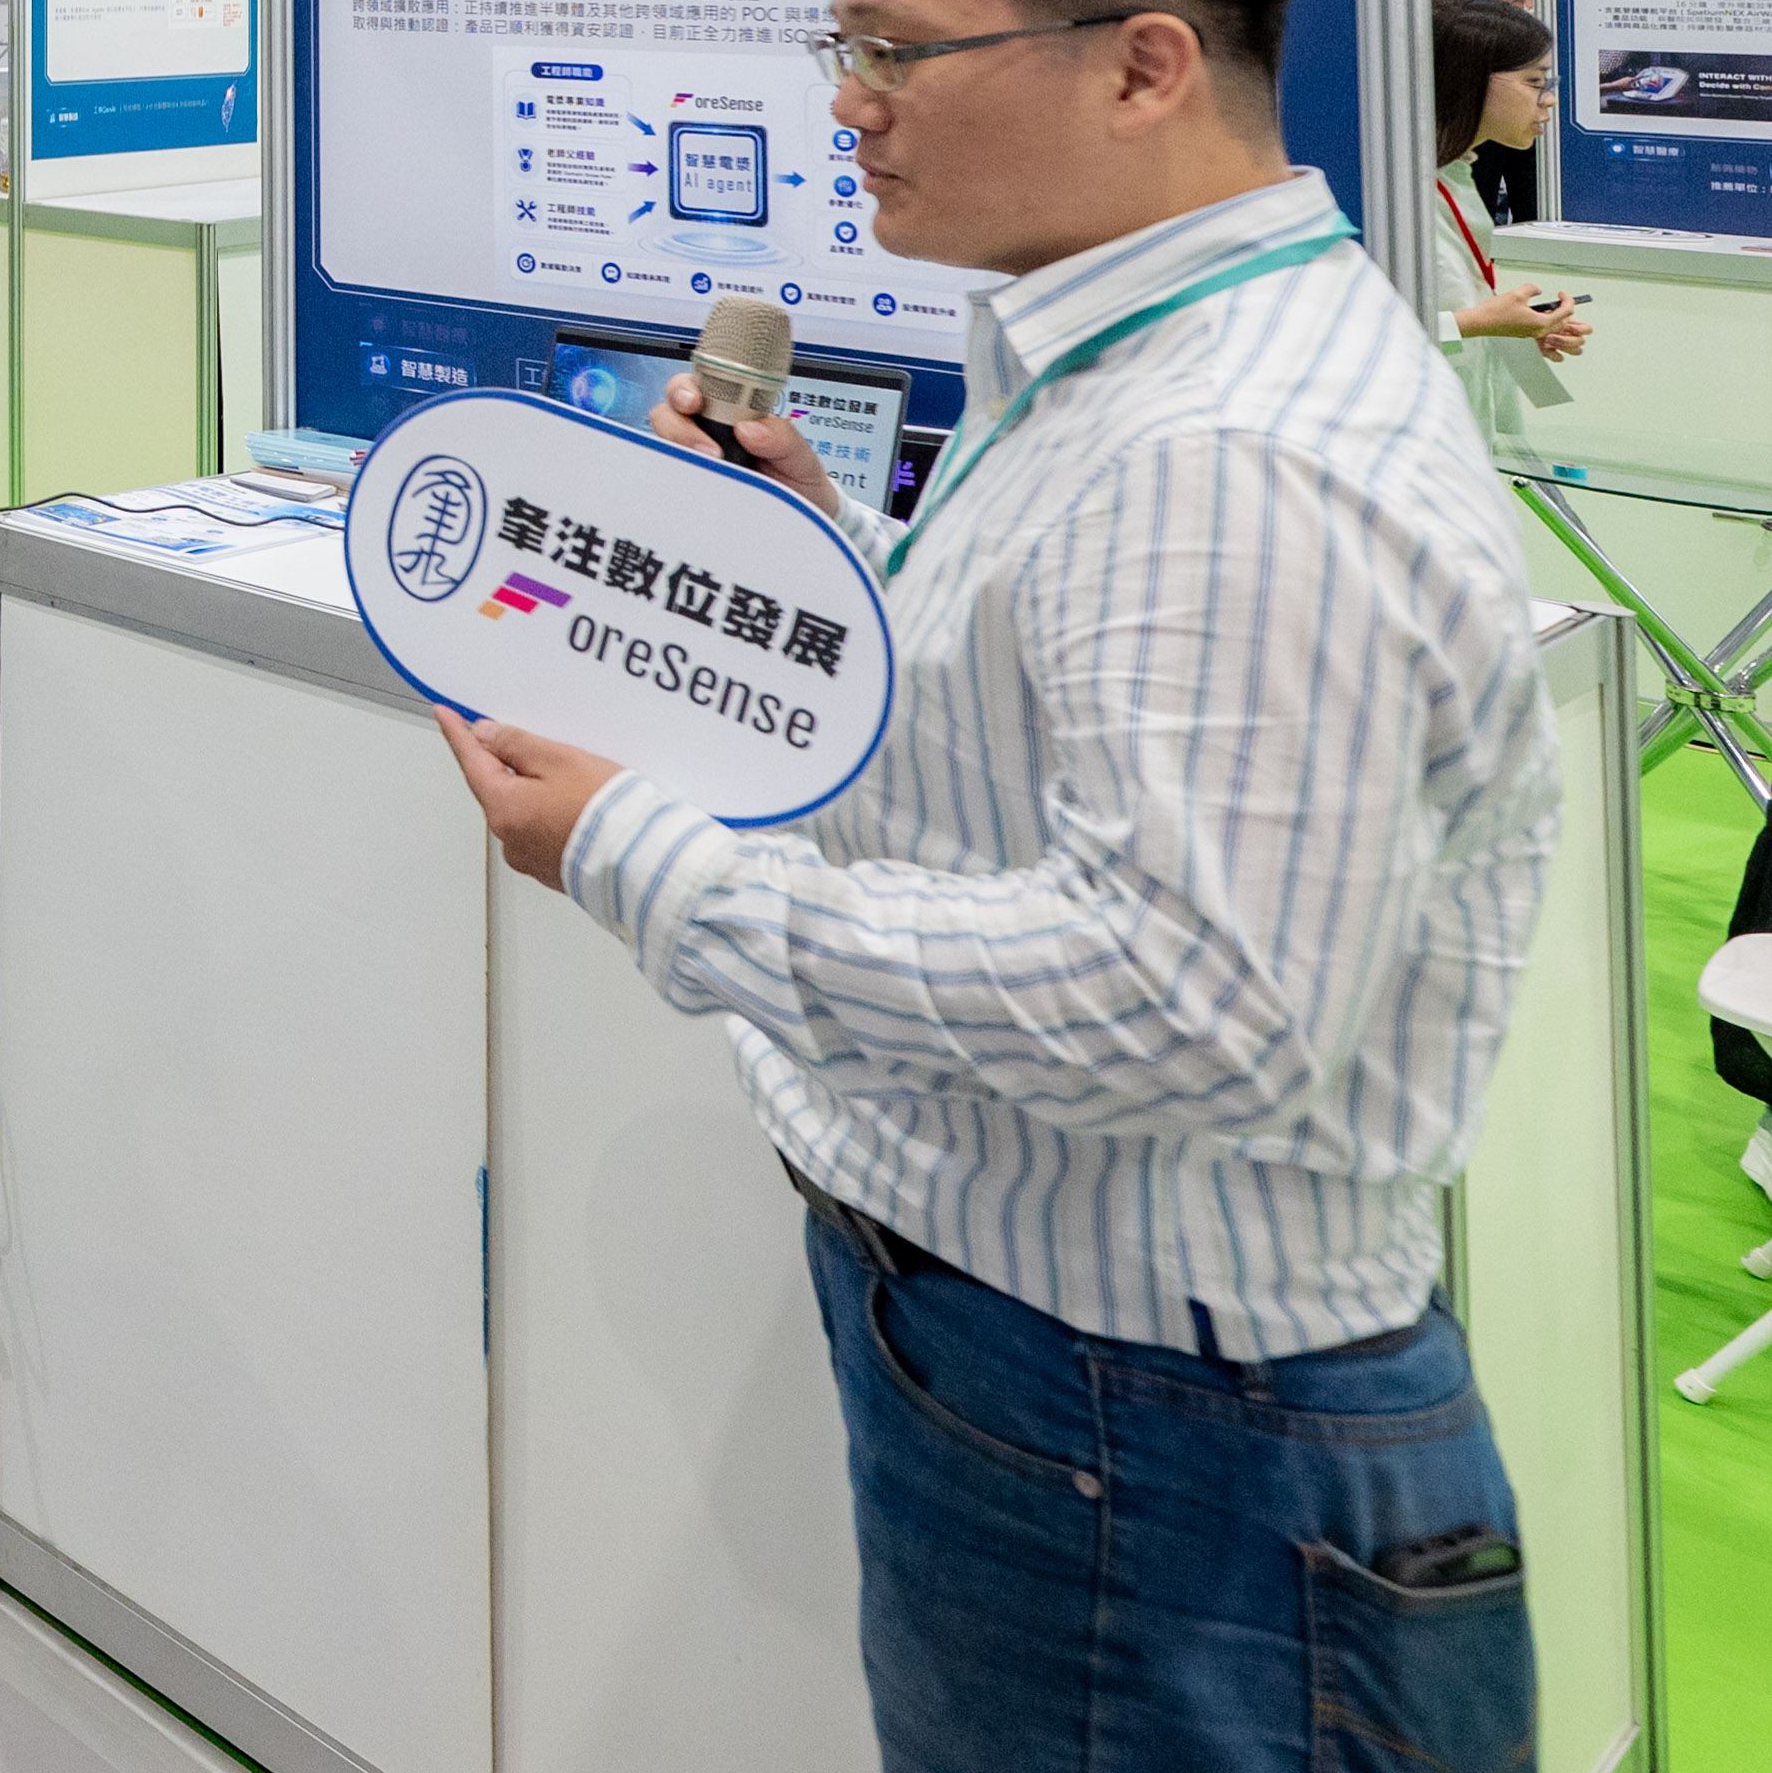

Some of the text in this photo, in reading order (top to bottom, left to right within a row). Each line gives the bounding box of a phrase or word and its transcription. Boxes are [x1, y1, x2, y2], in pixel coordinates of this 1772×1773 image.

[742, 3, 779, 21] POC
[1698, 72, 1746, 81] INTERACT
[1699, 81, 1730, 90] Decide
[670, 92, 765, 113] ForeSense
[684, 152, 753, 172] 智慧電漿
[684, 176, 754, 195] AI agent
[400, 359, 468, 388] 智慧製造
[478, 571, 818, 749] ForeSense
